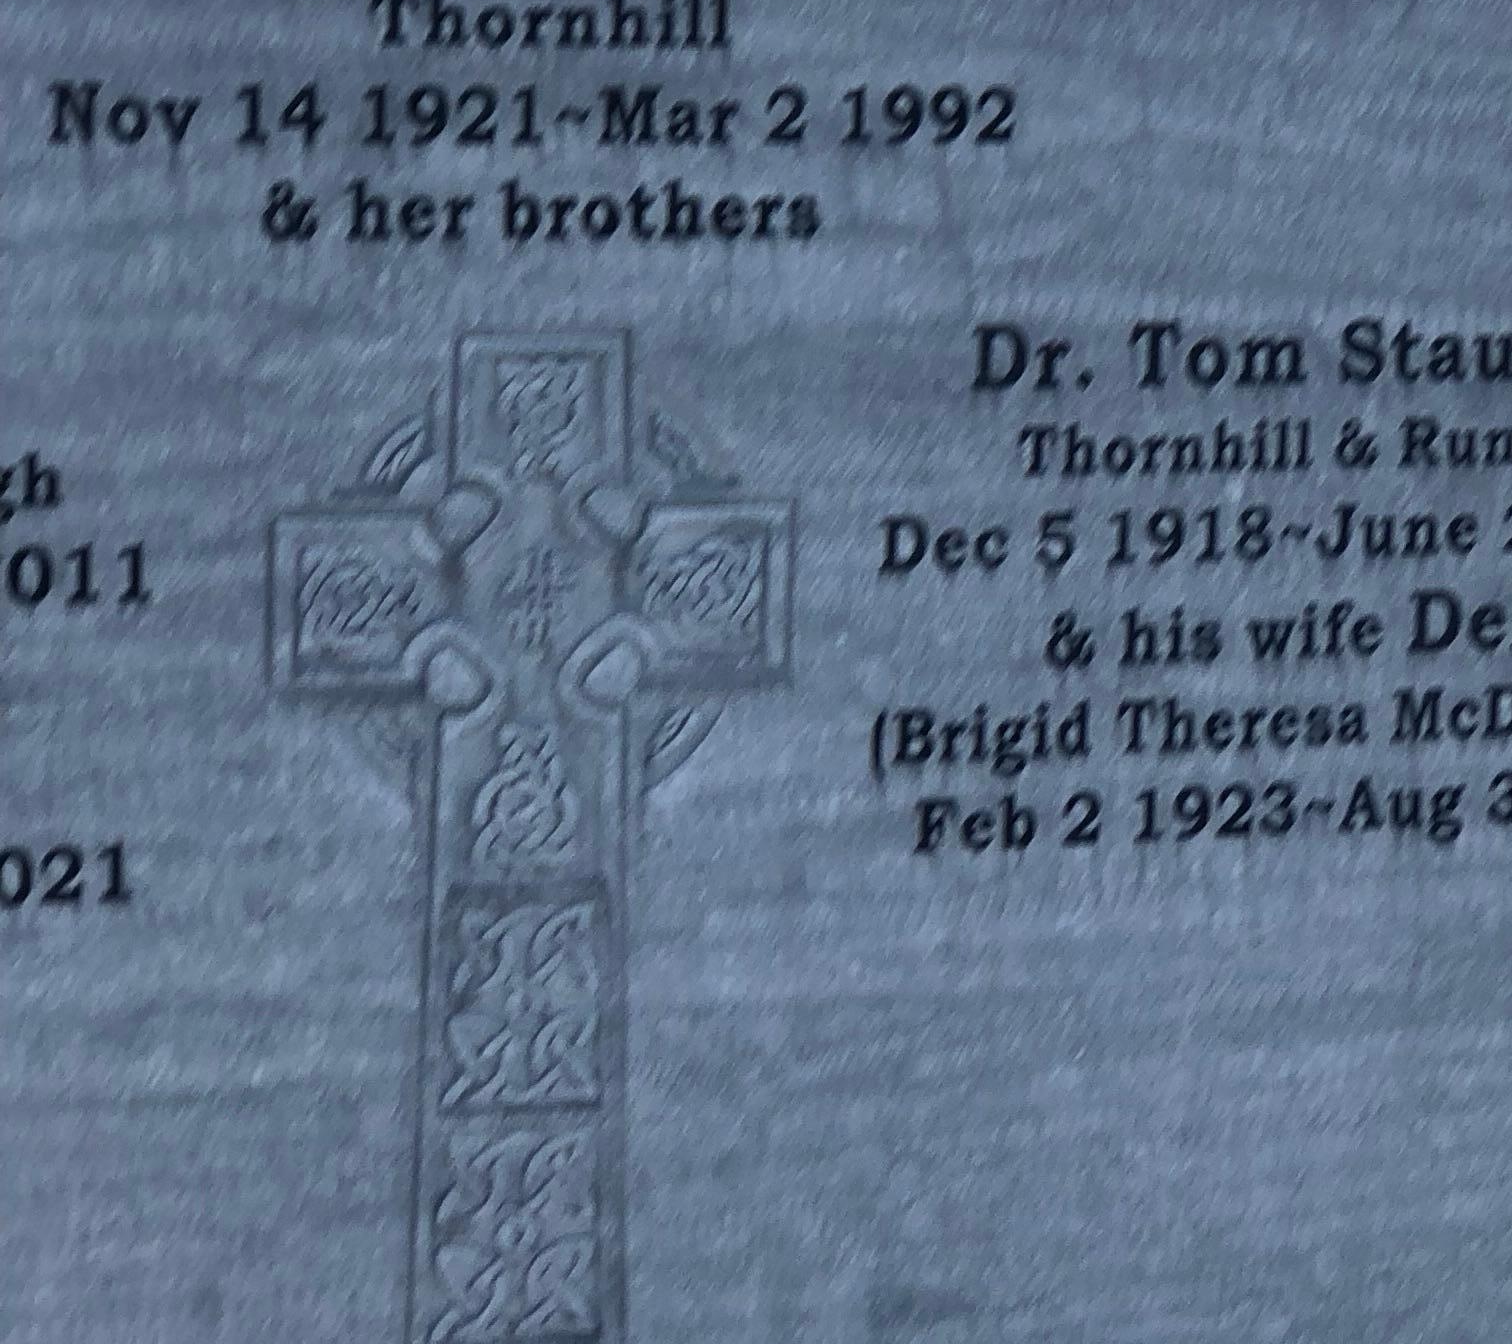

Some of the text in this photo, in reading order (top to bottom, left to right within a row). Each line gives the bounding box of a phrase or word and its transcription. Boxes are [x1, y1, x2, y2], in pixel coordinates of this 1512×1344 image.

[48, 80, 201, 151] Nov
[237, 82, 326, 149] 14
[765, 86, 807, 147] 2
[840, 85, 1016, 151] 1992
[261, 177, 821, 249] & her brothers
[970, 323, 1093, 397] Dr.
[1128, 320, 1307, 393] Tom
[1017, 418, 1312, 481] Thornhill
[1334, 418, 1379, 472] &
[5, 540, 152, 610] 011
[879, 515, 1010, 579] Dec
[1036, 507, 1077, 580] 5
[1044, 610, 1096, 674] &
[1119, 607, 1223, 672] his
[1247, 601, 1383, 666] wife
[871, 699, 1091, 784] (Brigid
[1115, 696, 1368, 758] Theresa
[914, 793, 1038, 855] Feb
[1062, 790, 1102, 847] 2
